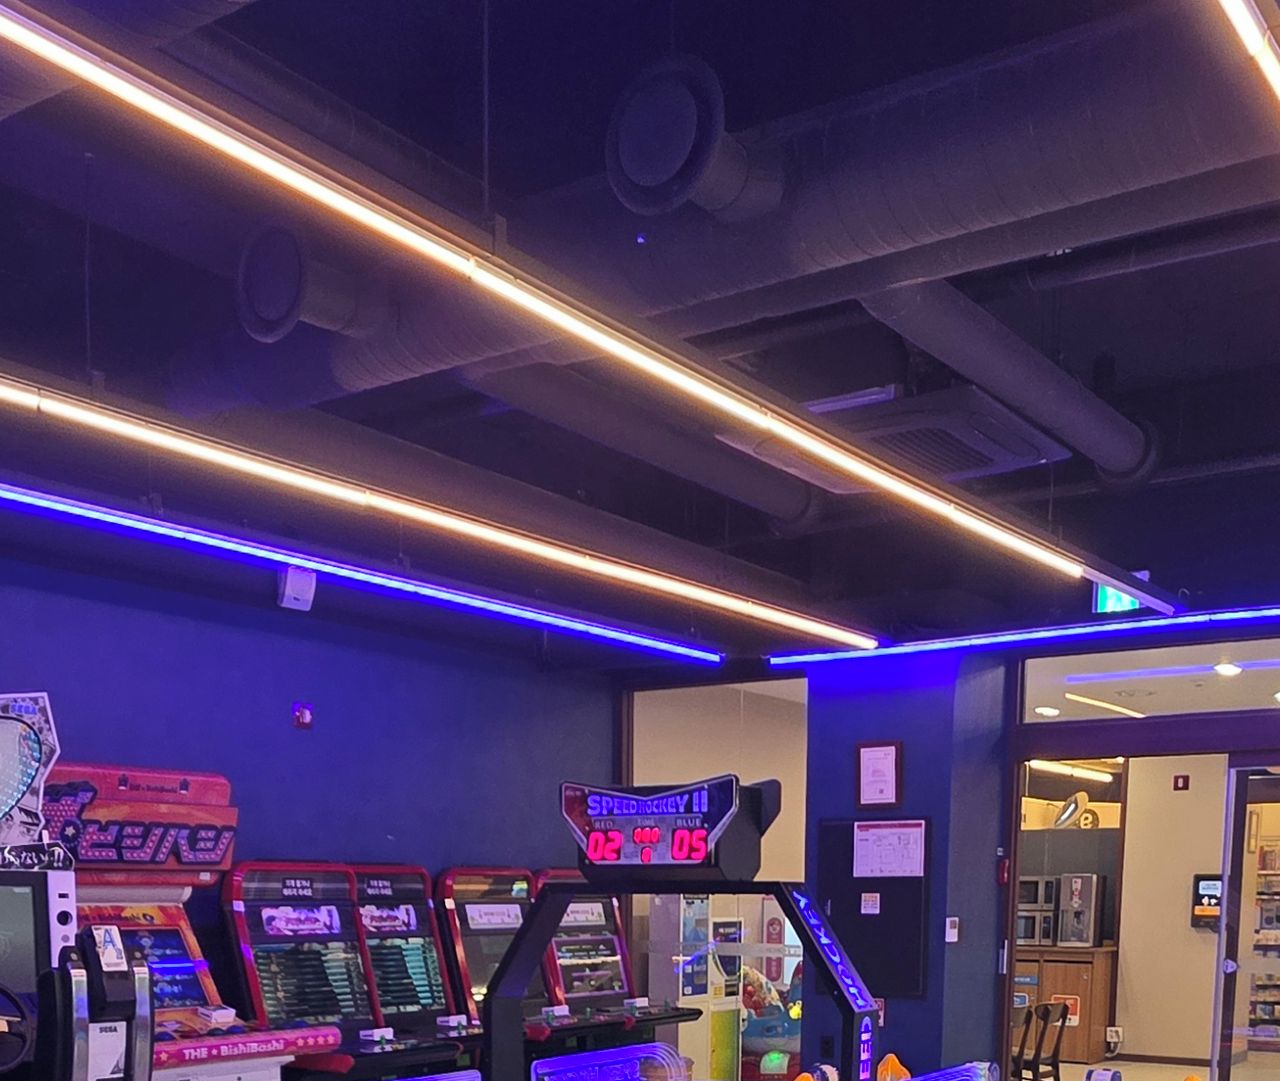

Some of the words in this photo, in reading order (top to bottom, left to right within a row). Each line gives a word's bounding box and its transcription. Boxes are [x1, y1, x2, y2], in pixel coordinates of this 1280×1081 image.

[10, 703, 39, 716] SEGA
[587, 794, 637, 817] SPEED
[637, 793, 689, 815] HOCKEY
[691, 790, 709, 813] II
[594, 820, 614, 830] RED
[676, 817, 702, 828] BLUE
[587, 830, 624, 861] 02
[671, 828, 708, 861] 05
[99, 1024, 119, 1035] SEGA
[182, 1046, 209, 1061] THE
[219, 1038, 286, 1058] BishiBashi
